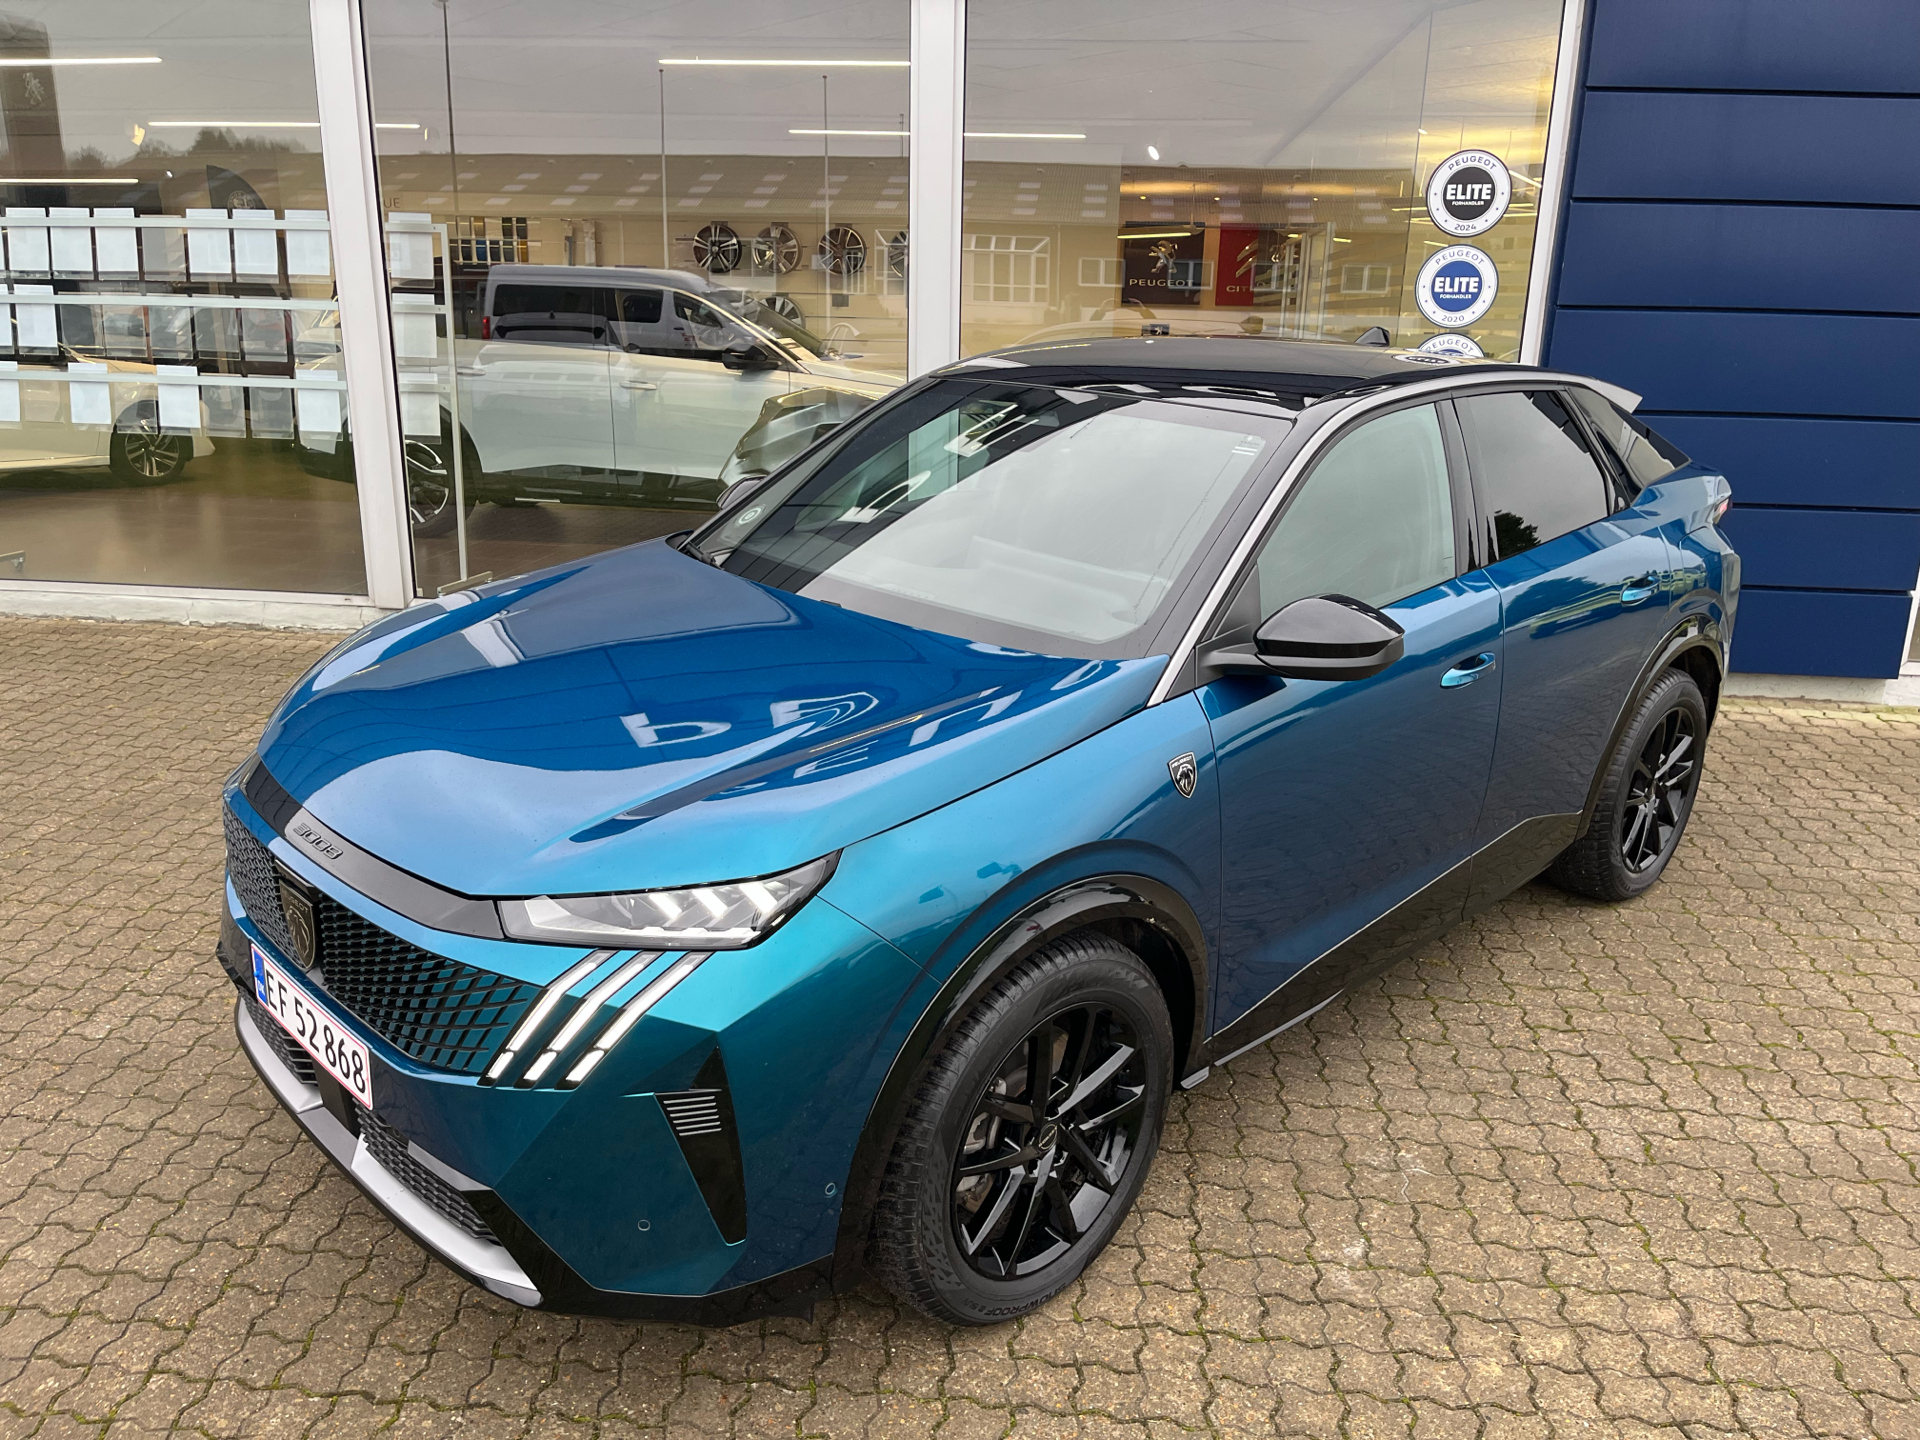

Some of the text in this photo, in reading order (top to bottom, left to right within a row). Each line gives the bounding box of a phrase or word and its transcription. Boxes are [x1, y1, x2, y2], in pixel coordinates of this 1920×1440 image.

[1448, 155, 1497, 171] PEUGEOT
[1446, 183, 1492, 200] ELITE
[1454, 223, 1477, 231] 2024
[1435, 249, 1485, 265] PEUGEOT
[1129, 278, 1195, 287] PEUGEOT
[1433, 276, 1479, 293] ELITE
[1441, 314, 1465, 323] 2020
[1425, 338, 1474, 352] PEUGEOT
[292, 822, 344, 860] 3008
[266, 969, 366, 1094] EF 52 868
